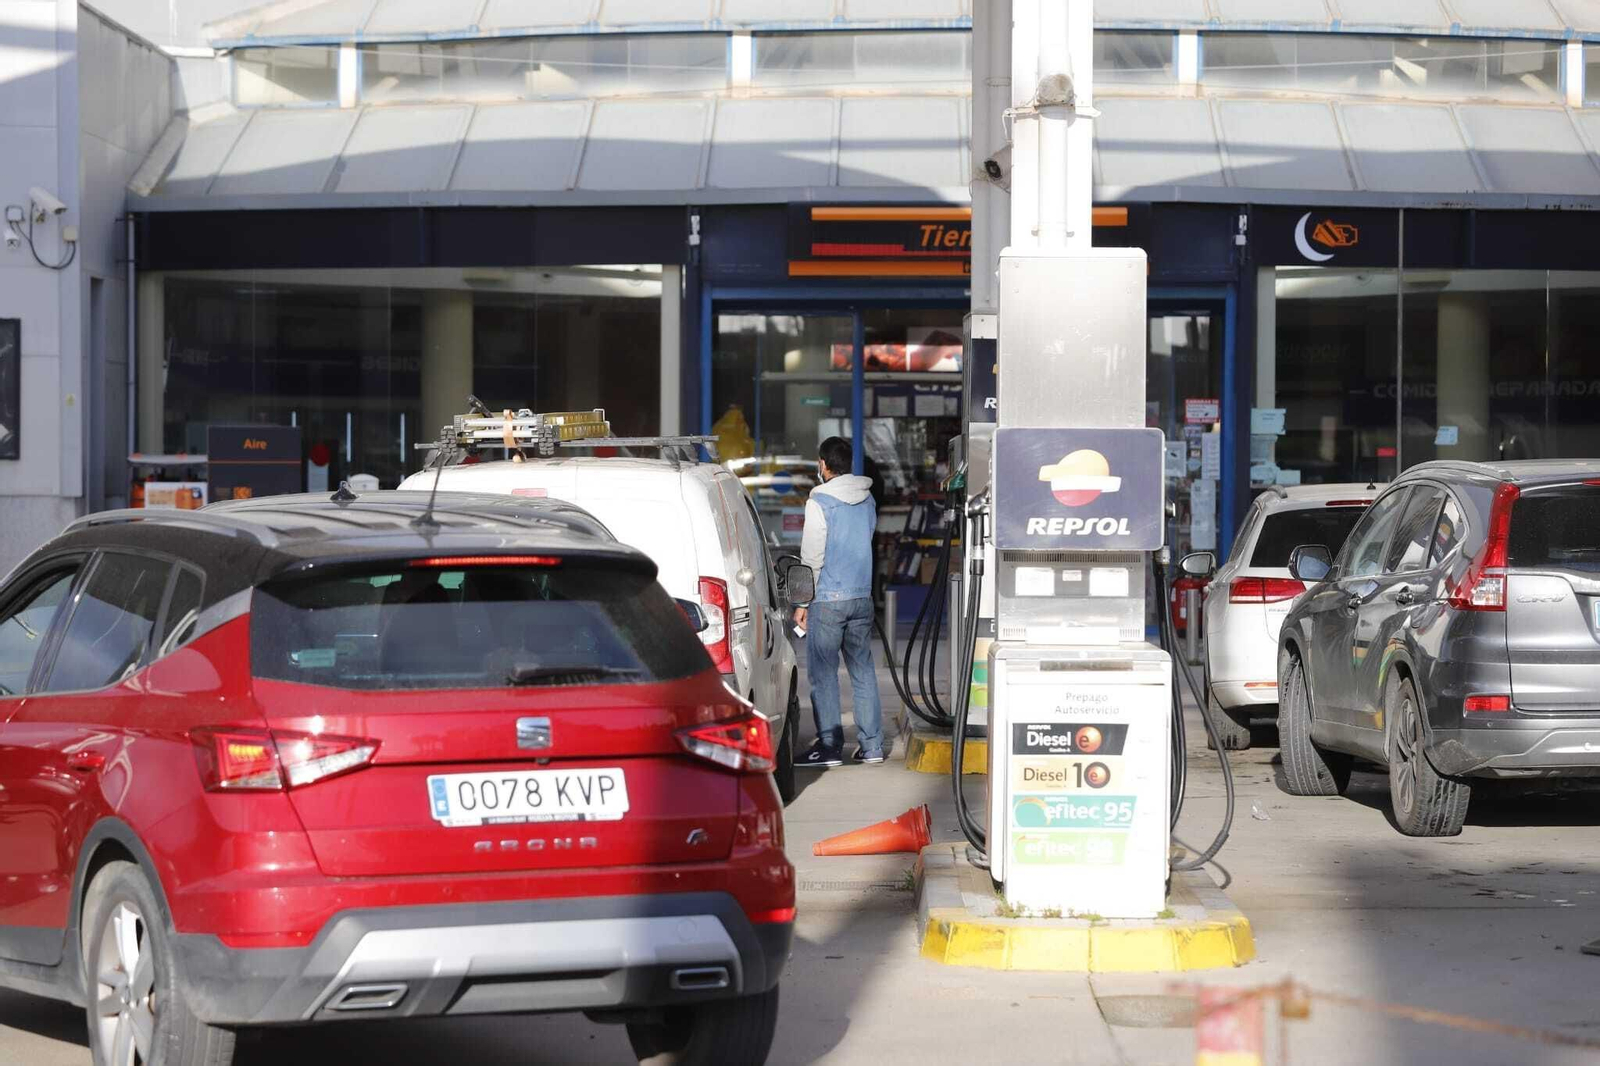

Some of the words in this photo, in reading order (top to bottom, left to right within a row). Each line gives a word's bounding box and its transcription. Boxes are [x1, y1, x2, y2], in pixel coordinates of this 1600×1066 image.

[243, 438, 267, 450] Aire
[1026, 517, 1131, 536] REPSOL
[1065, 692, 1109, 704] Prepago
[1055, 705, 1120, 715] Autoservicio
[1026, 731, 1072, 746] Diesel
[1023, 767, 1067, 781] Diesel
[458, 778, 543, 811] 0078
[555, 775, 615, 806] KVP
[1045, 802, 1101, 819] efitec
[1104, 801, 1133, 822] 95
